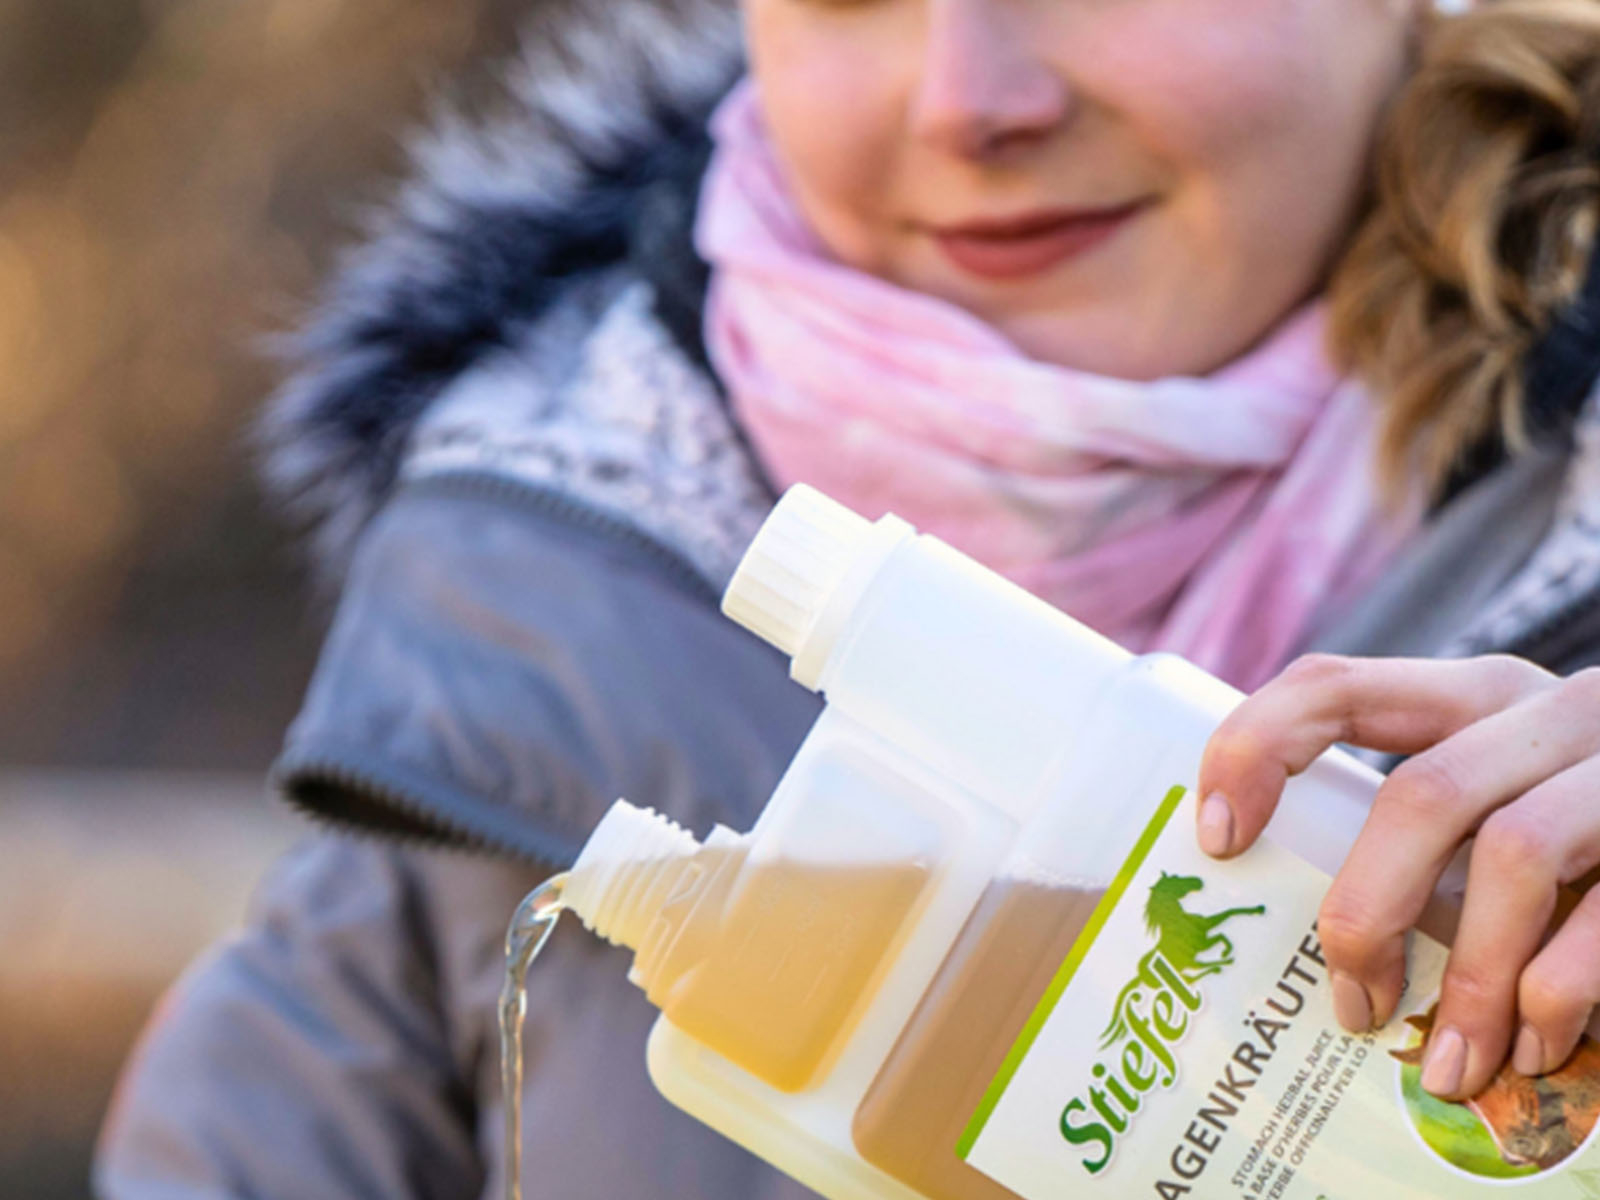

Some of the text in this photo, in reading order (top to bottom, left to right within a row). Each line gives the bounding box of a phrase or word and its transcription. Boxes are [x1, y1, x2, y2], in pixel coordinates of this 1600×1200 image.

[1059, 956, 1203, 1175] Stiefel
[1230, 1028, 1334, 1188] STOMACH HERBAL JUICE
[1249, 1158, 1277, 1194] BASE
[1271, 1092, 1317, 1158] D'HERBES
[1310, 1054, 1342, 1093] POUR
[1335, 1034, 1355, 1054] LA
[1289, 1092, 1339, 1165] OFFICINALI
[1332, 1066, 1355, 1094] PER
[1349, 1045, 1368, 1067] LO
